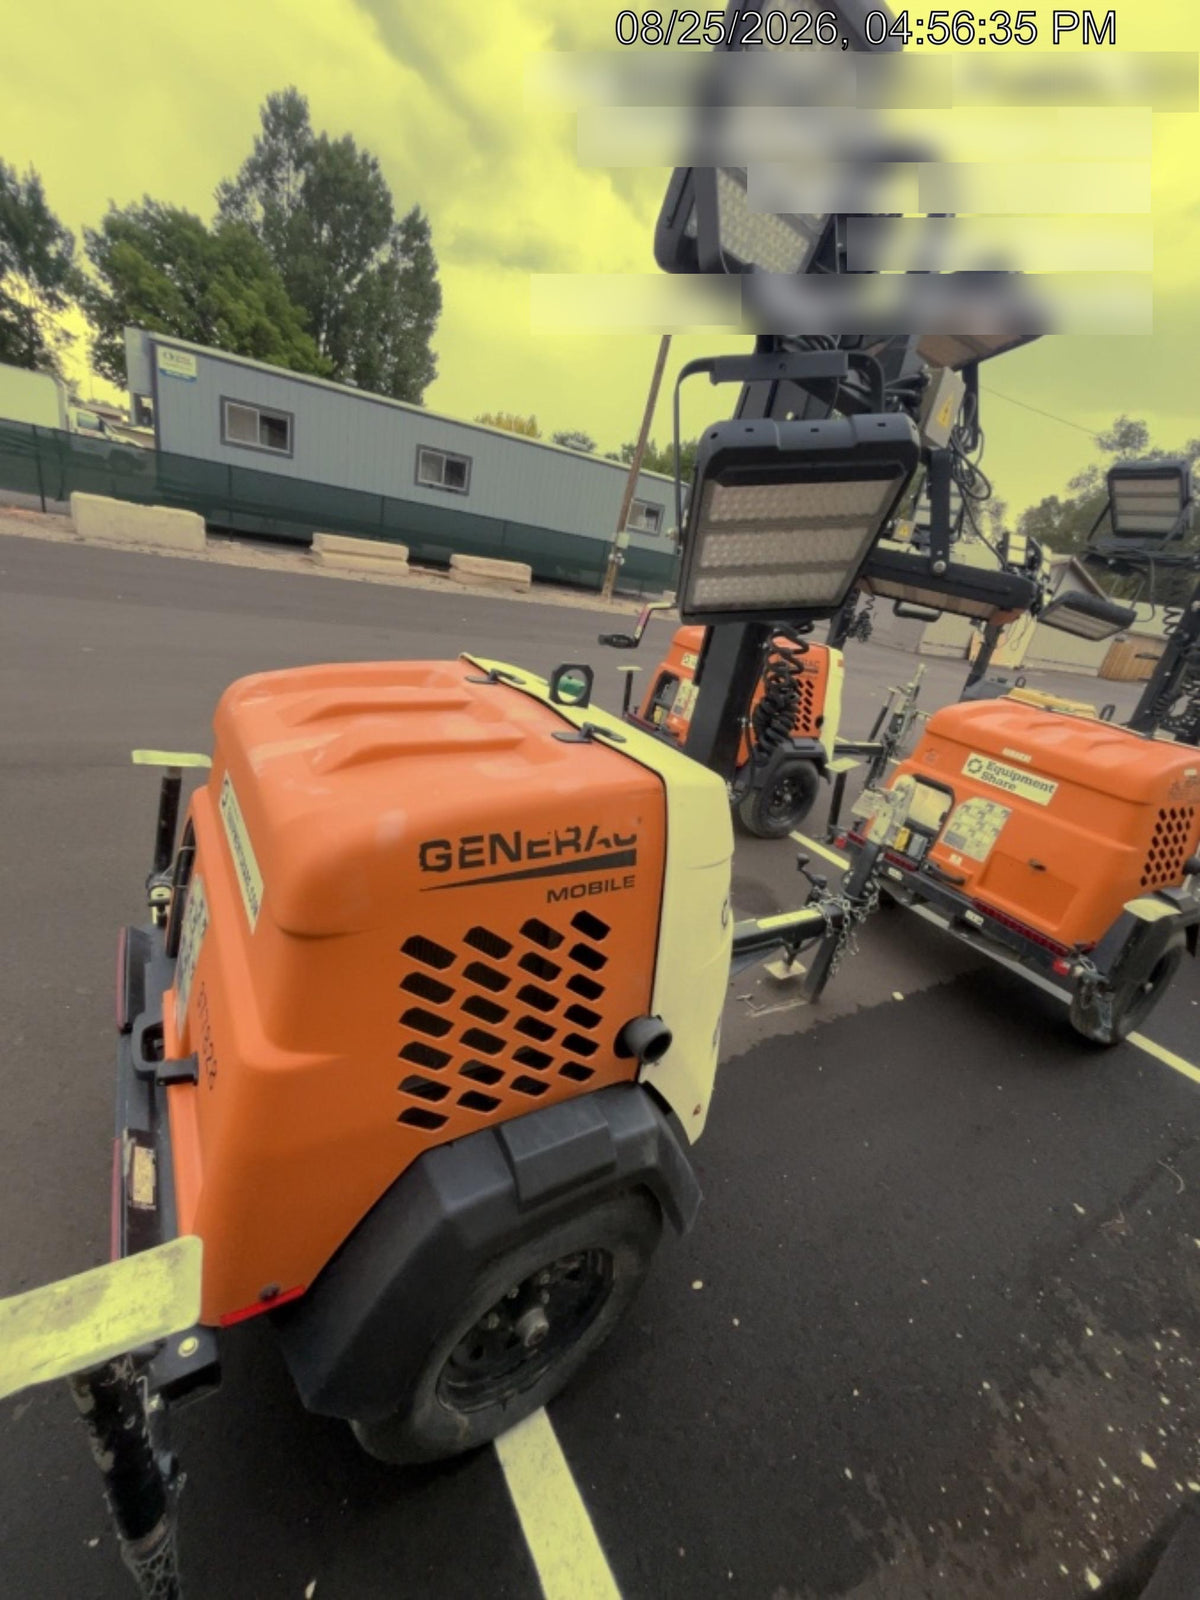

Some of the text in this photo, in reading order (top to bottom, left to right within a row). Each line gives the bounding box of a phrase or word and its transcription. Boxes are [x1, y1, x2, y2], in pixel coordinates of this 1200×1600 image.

[981, 771, 1017, 792] Share
[986, 761, 1055, 793] Equipment
[547, 875, 635, 903] MOBILE
